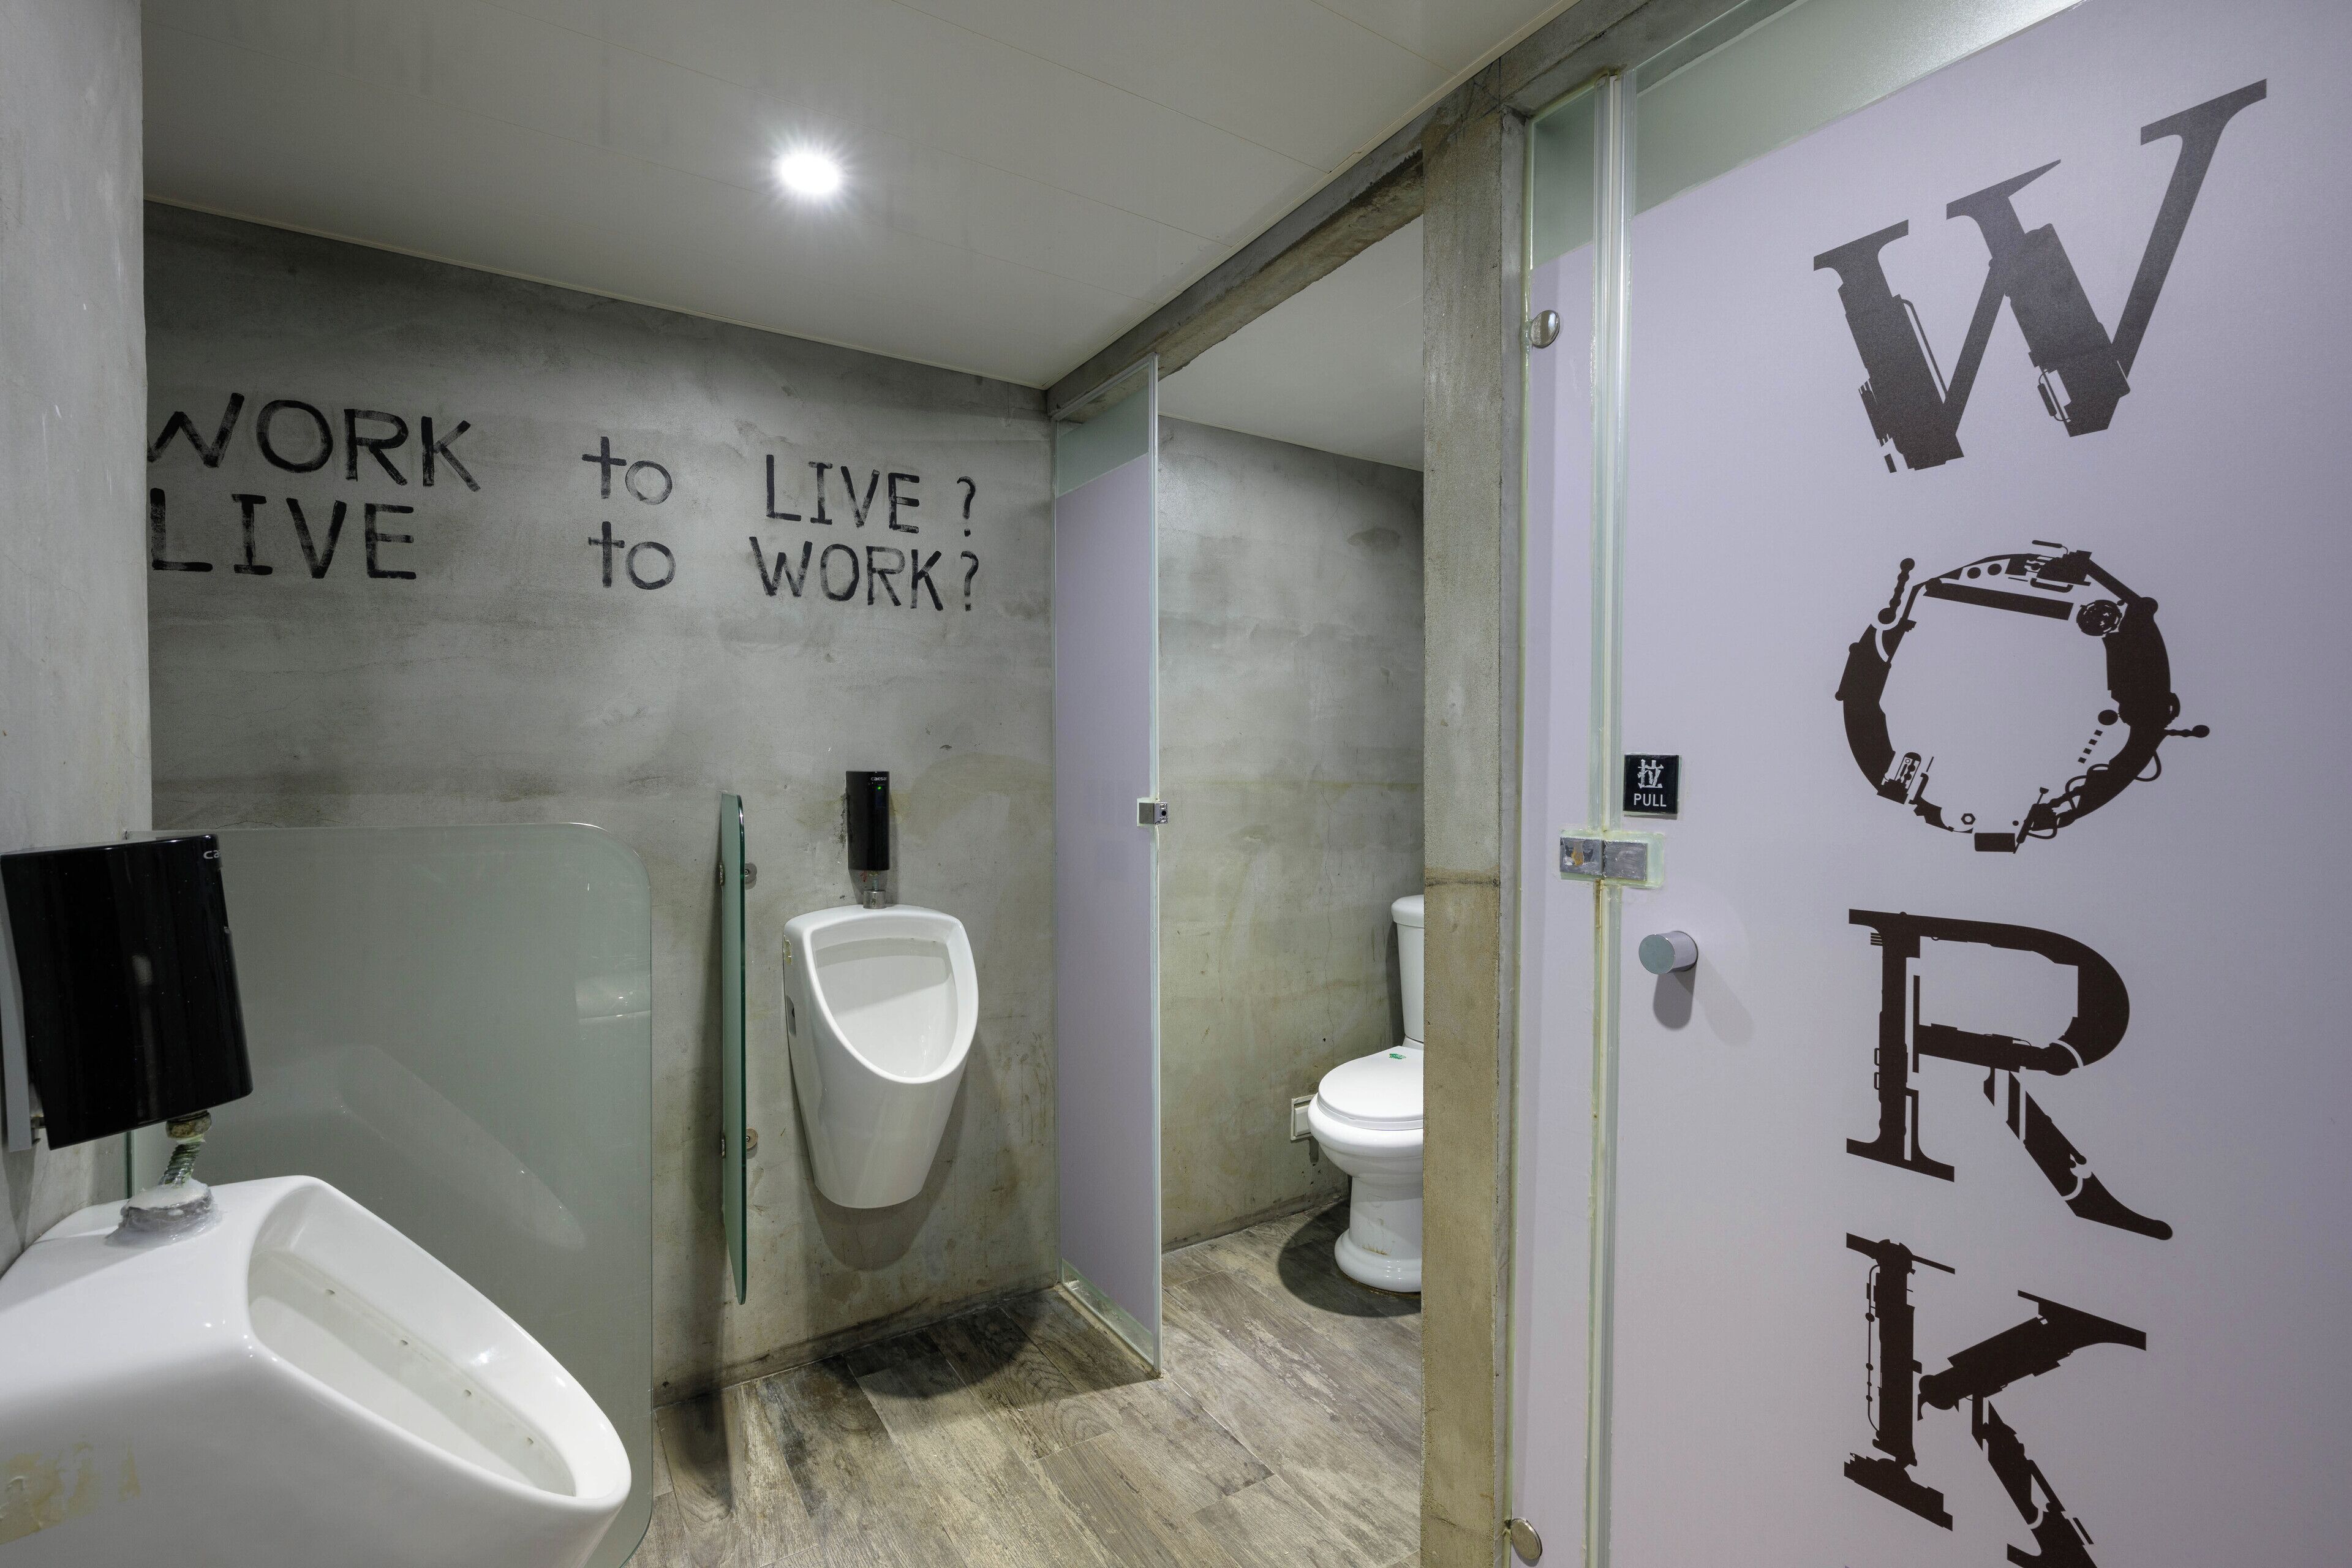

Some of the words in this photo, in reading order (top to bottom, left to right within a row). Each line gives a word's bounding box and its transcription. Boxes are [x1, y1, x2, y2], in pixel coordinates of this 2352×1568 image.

[148, 393, 481, 491] WORK
[581, 436, 673, 505] to
[150, 488, 417, 579] LIVE
[588, 521, 676, 590] to
[1634, 793, 1667, 807] PULL
[1637, 760, 1664, 789] 拉
[1813, 78, 2267, 1568] WORK
